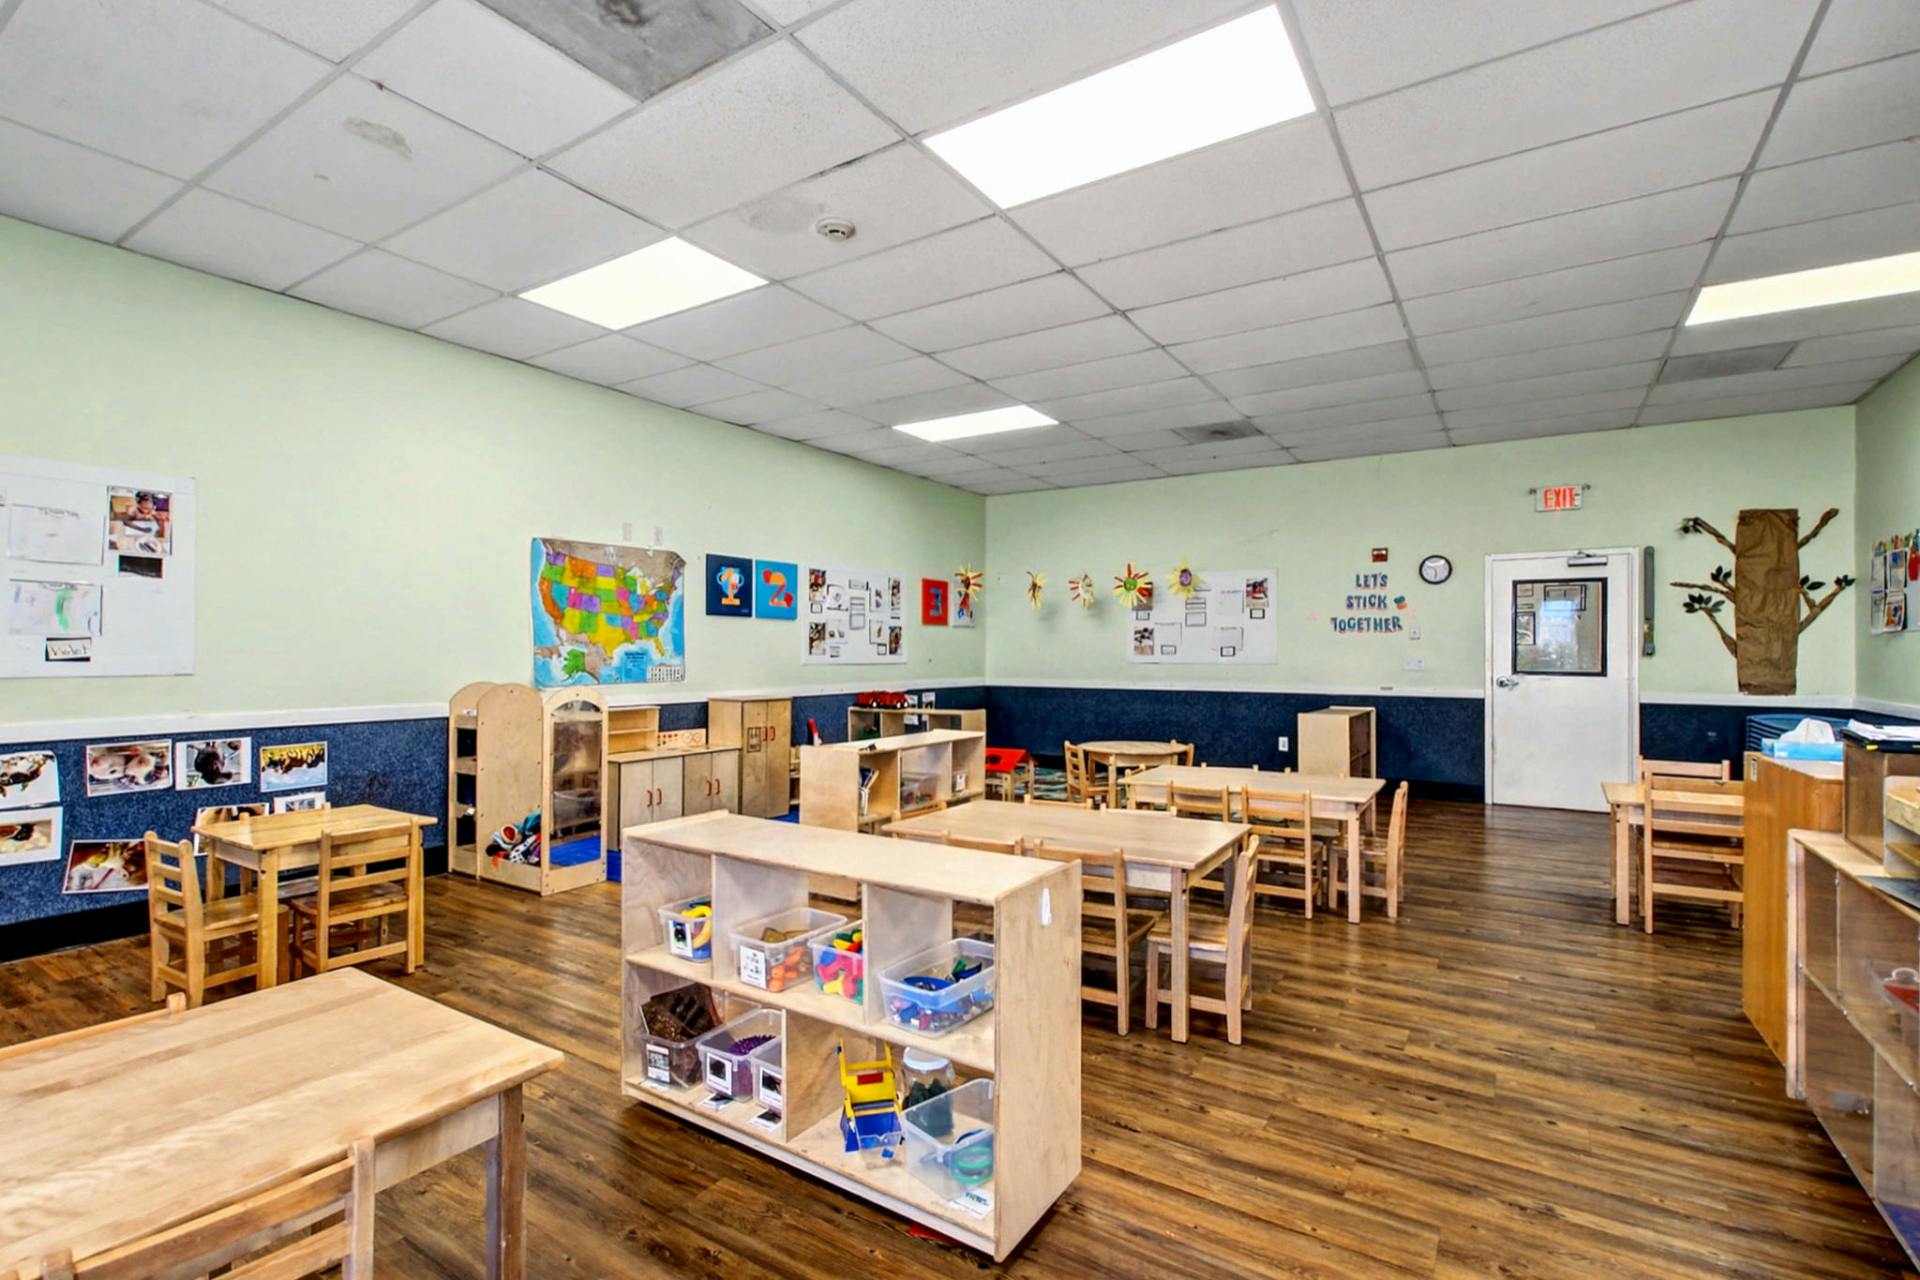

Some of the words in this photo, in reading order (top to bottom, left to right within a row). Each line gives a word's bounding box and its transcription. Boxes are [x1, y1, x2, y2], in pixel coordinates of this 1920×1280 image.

[1543, 486, 1576, 509] EXIT
[762, 569, 794, 608] 2
[1355, 572, 1388, 588] LET'S
[929, 587, 942, 617] 3
[1346, 594, 1388, 609] STICK
[1330, 616, 1403, 633] TOGETHER
